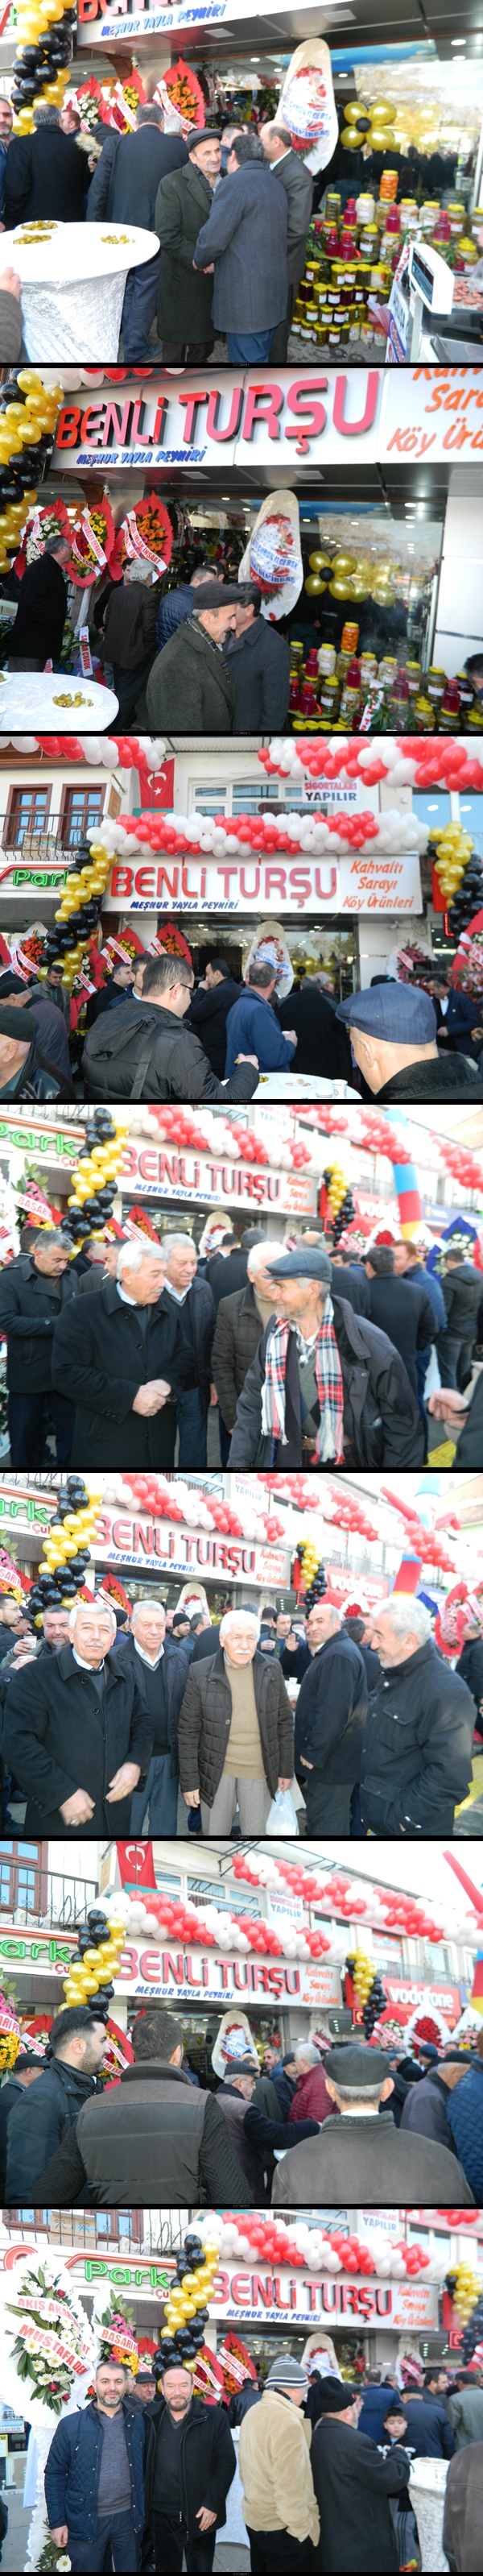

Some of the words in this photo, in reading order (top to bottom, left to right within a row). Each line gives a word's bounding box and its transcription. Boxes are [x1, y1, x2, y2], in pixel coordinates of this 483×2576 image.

[142, 13, 174, 30] YAYLA
[56, 397, 168, 448] BENLİ
[179, 371, 380, 455] TURŞU
[386, 426, 436, 458] Köy
[121, 451, 153, 464] YAYLA
[305, 792, 357, 801] YAPILIR
[350, 861, 404, 874] Kahvaltı
[110, 866, 206, 898] BENLİ
[217, 867, 337, 908] TURŞU
[357, 877, 398, 894] Sarayı
[171, 902, 198, 910] YAYLA
[201, 899, 239, 910] PEYNİRİ
[343, 895, 365, 911] Köy
[367, 893, 415, 909] Ürünleri
[118, 1145, 200, 1188] BENLİ
[207, 1163, 281, 1206] TURŞU
[90, 1514, 175, 1558] BENLİ
[181, 1534, 255, 1578] TURŞU
[107, 1552, 143, 1563] MEŞHUR
[145, 1558, 167, 1568] YAYLA
[270, 1904, 302, 1919] YAPILIR
[114, 1947, 209, 1987] BENLİ
[216, 1959, 300, 2001] TURŞU
[135, 1985, 175, 1997] MEŞHUR
[176, 1988, 201, 1997] YAYLA
[388, 1985, 454, 2009] vodafone
[363, 2217, 397, 2231] YAPILIR
[85, 2259, 170, 2288] Park
[208, 2270, 297, 2309] BENLİ
[304, 2280, 393, 2323] TURŞU
[226, 2308, 263, 2320] MEŞHUR
[265, 2311, 288, 2321] YAYLA
[19, 2324, 76, 2367] MUSTAFA
